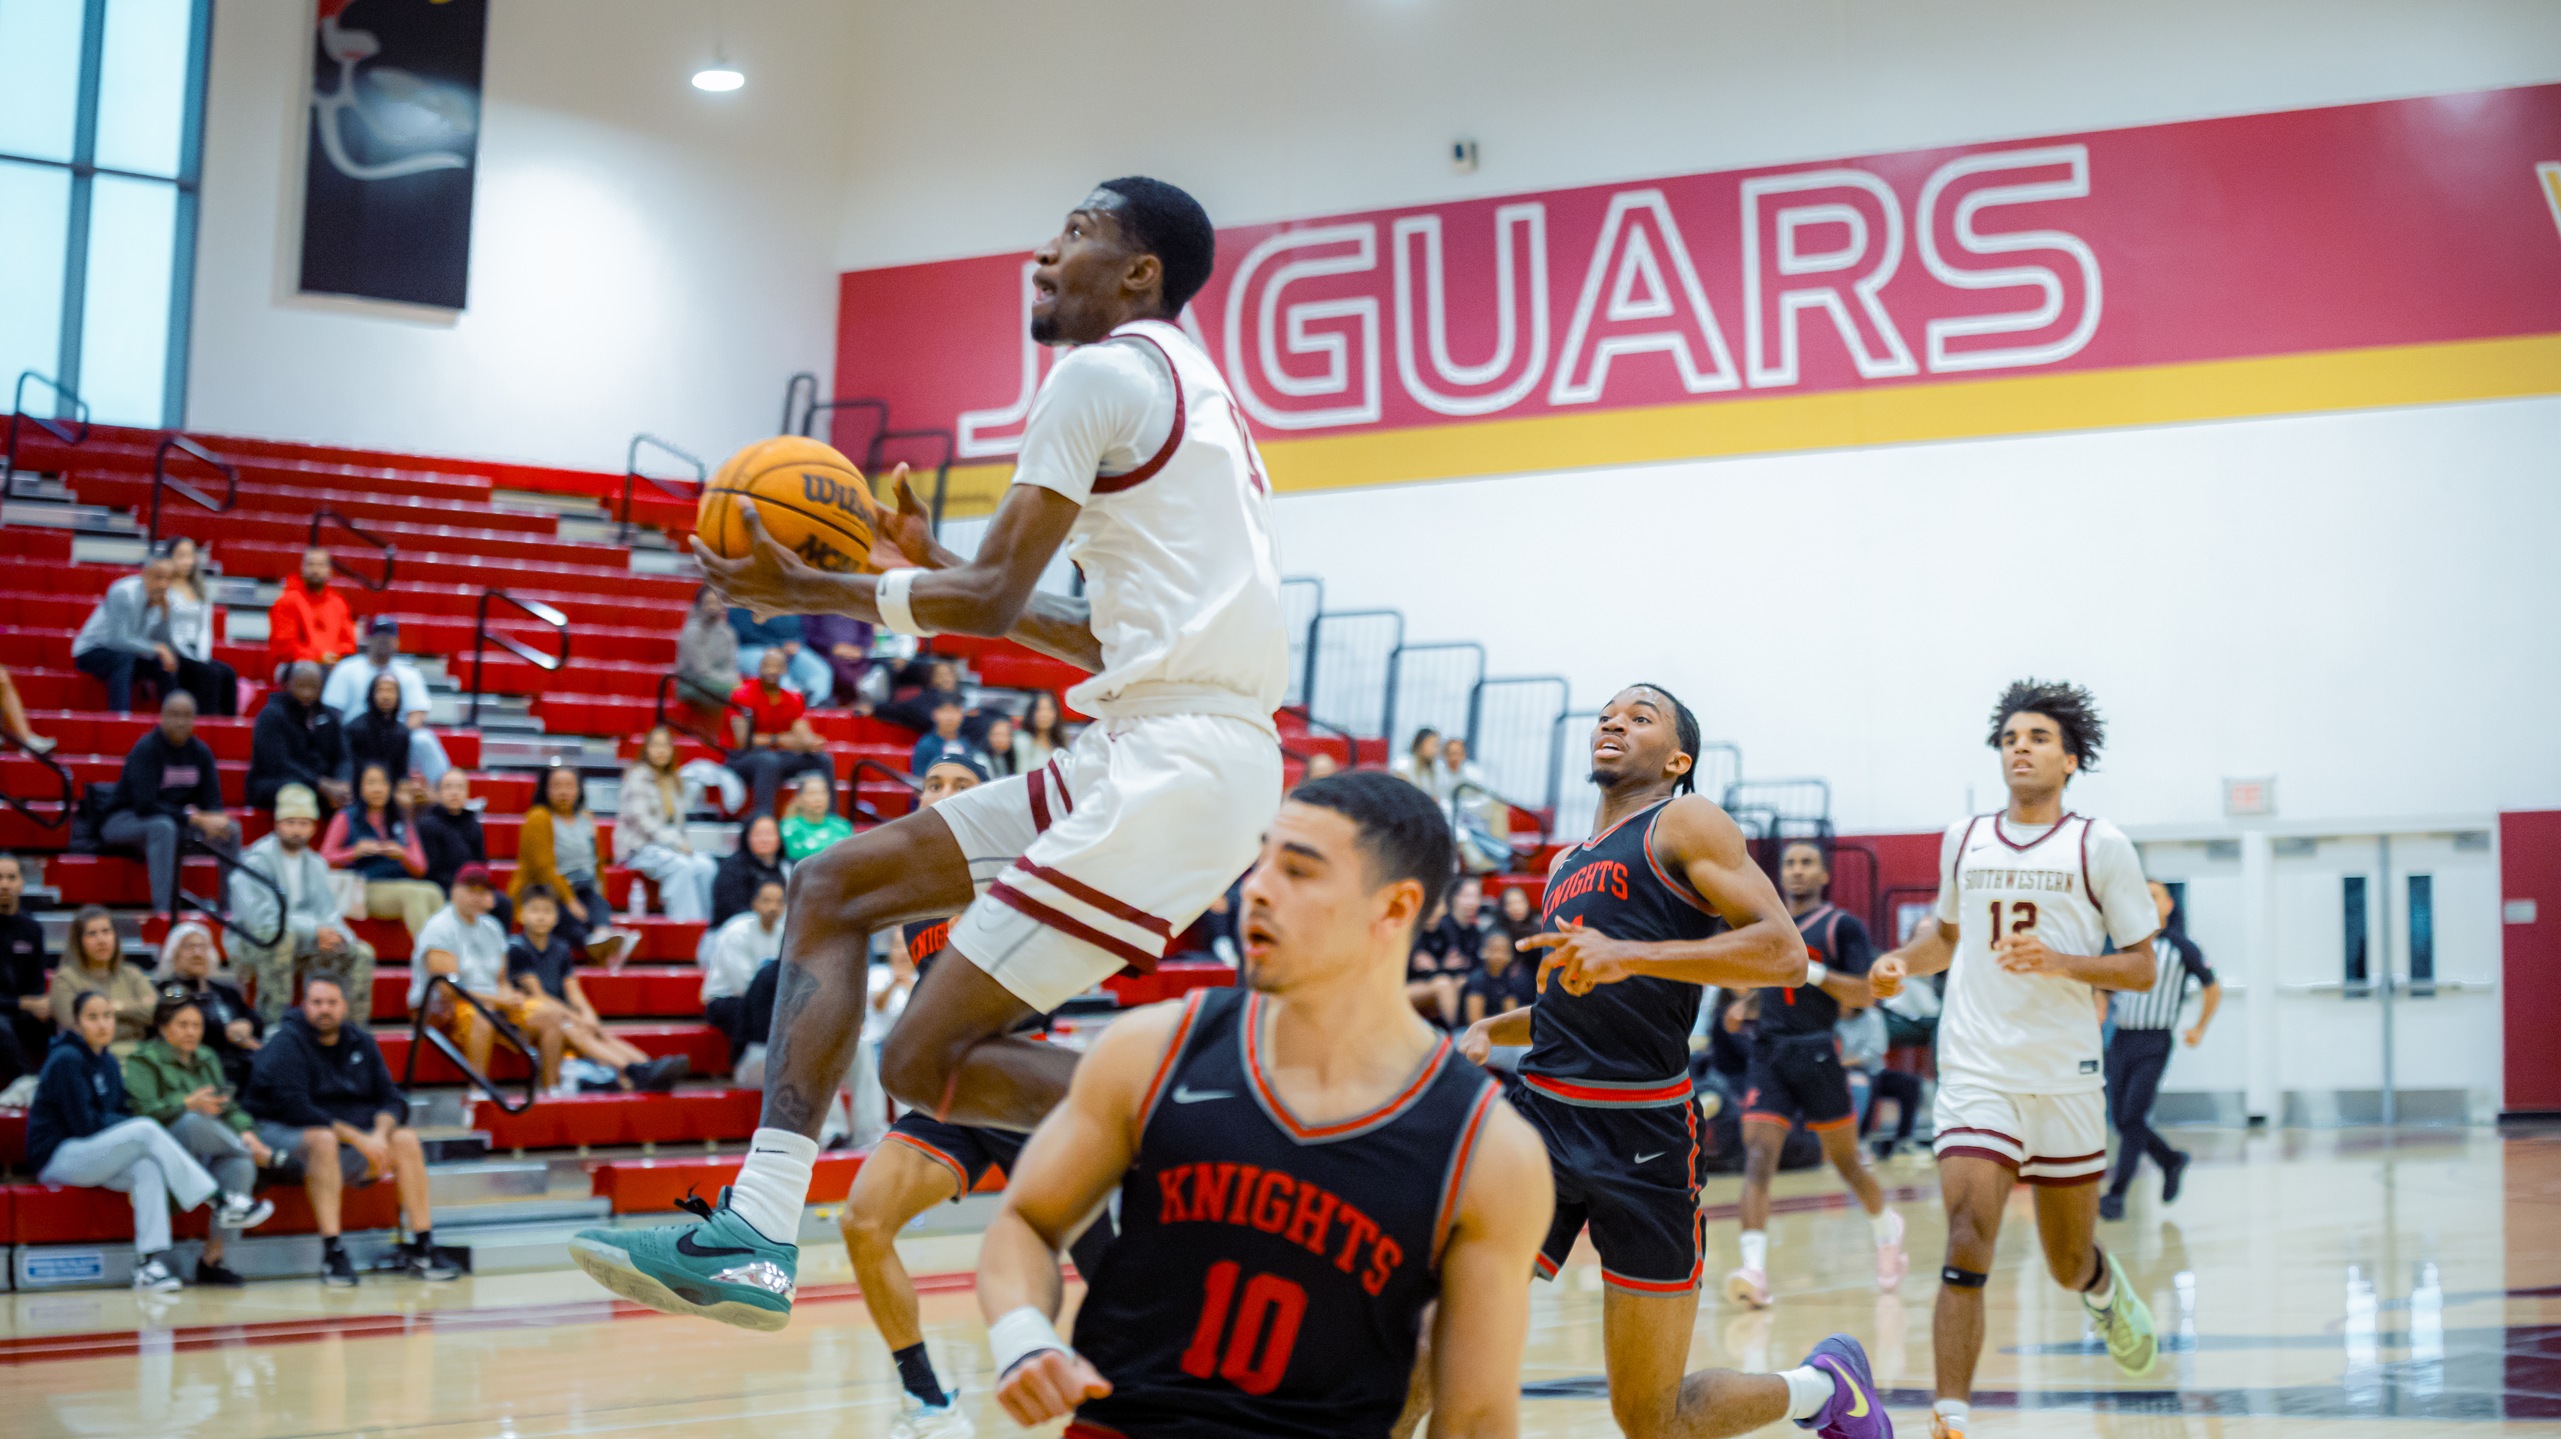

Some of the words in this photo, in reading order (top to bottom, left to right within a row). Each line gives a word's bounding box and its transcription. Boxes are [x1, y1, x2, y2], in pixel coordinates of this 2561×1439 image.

[957, 143, 2103, 459] JGUARS
[1965, 868, 2075, 893] SOUTHWESTERN
[1157, 1161, 1404, 1297] KNIGHTS
[1180, 1259, 1309, 1396] 10
